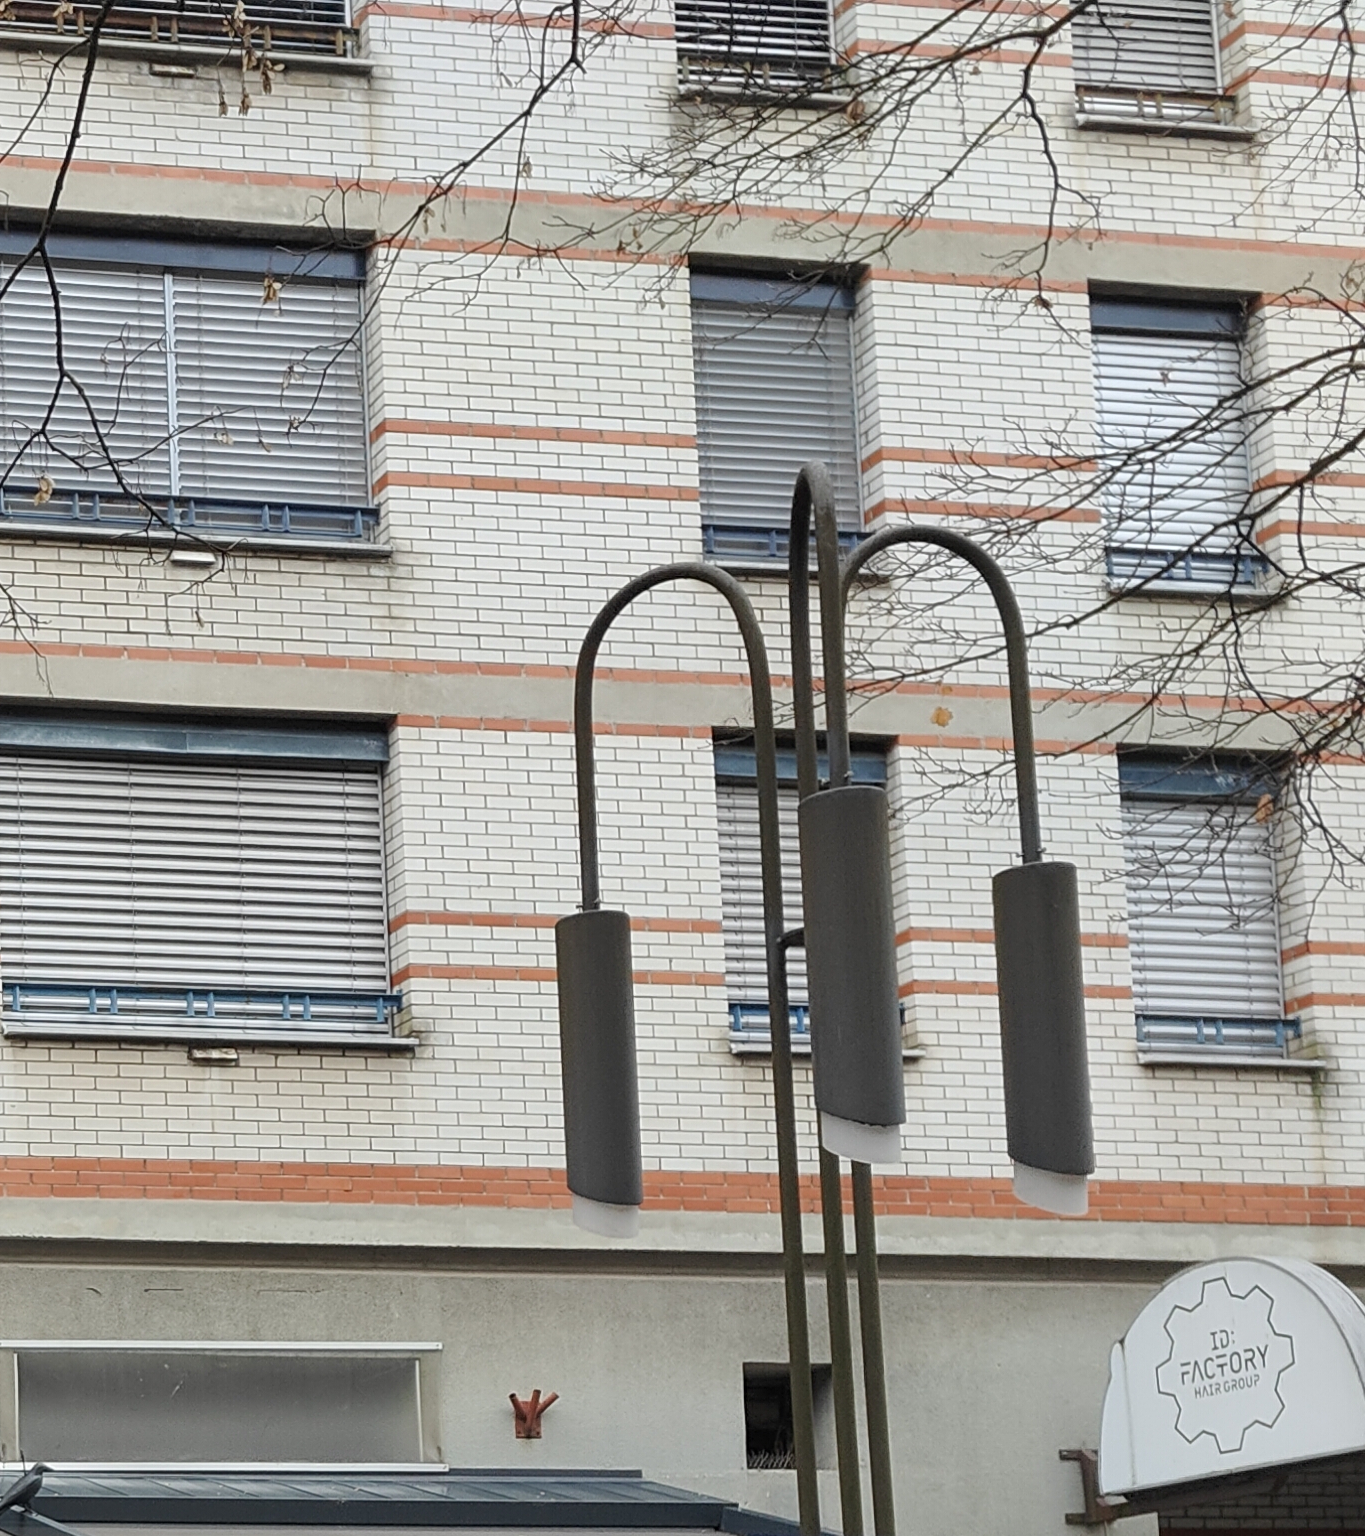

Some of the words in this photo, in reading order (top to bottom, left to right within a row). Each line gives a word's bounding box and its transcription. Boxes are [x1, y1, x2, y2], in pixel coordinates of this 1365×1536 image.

[1180, 1344, 1269, 1386] FACTORY
[1194, 1383, 1222, 1400] HAIR
[1223, 1373, 1261, 1394] GROUP
